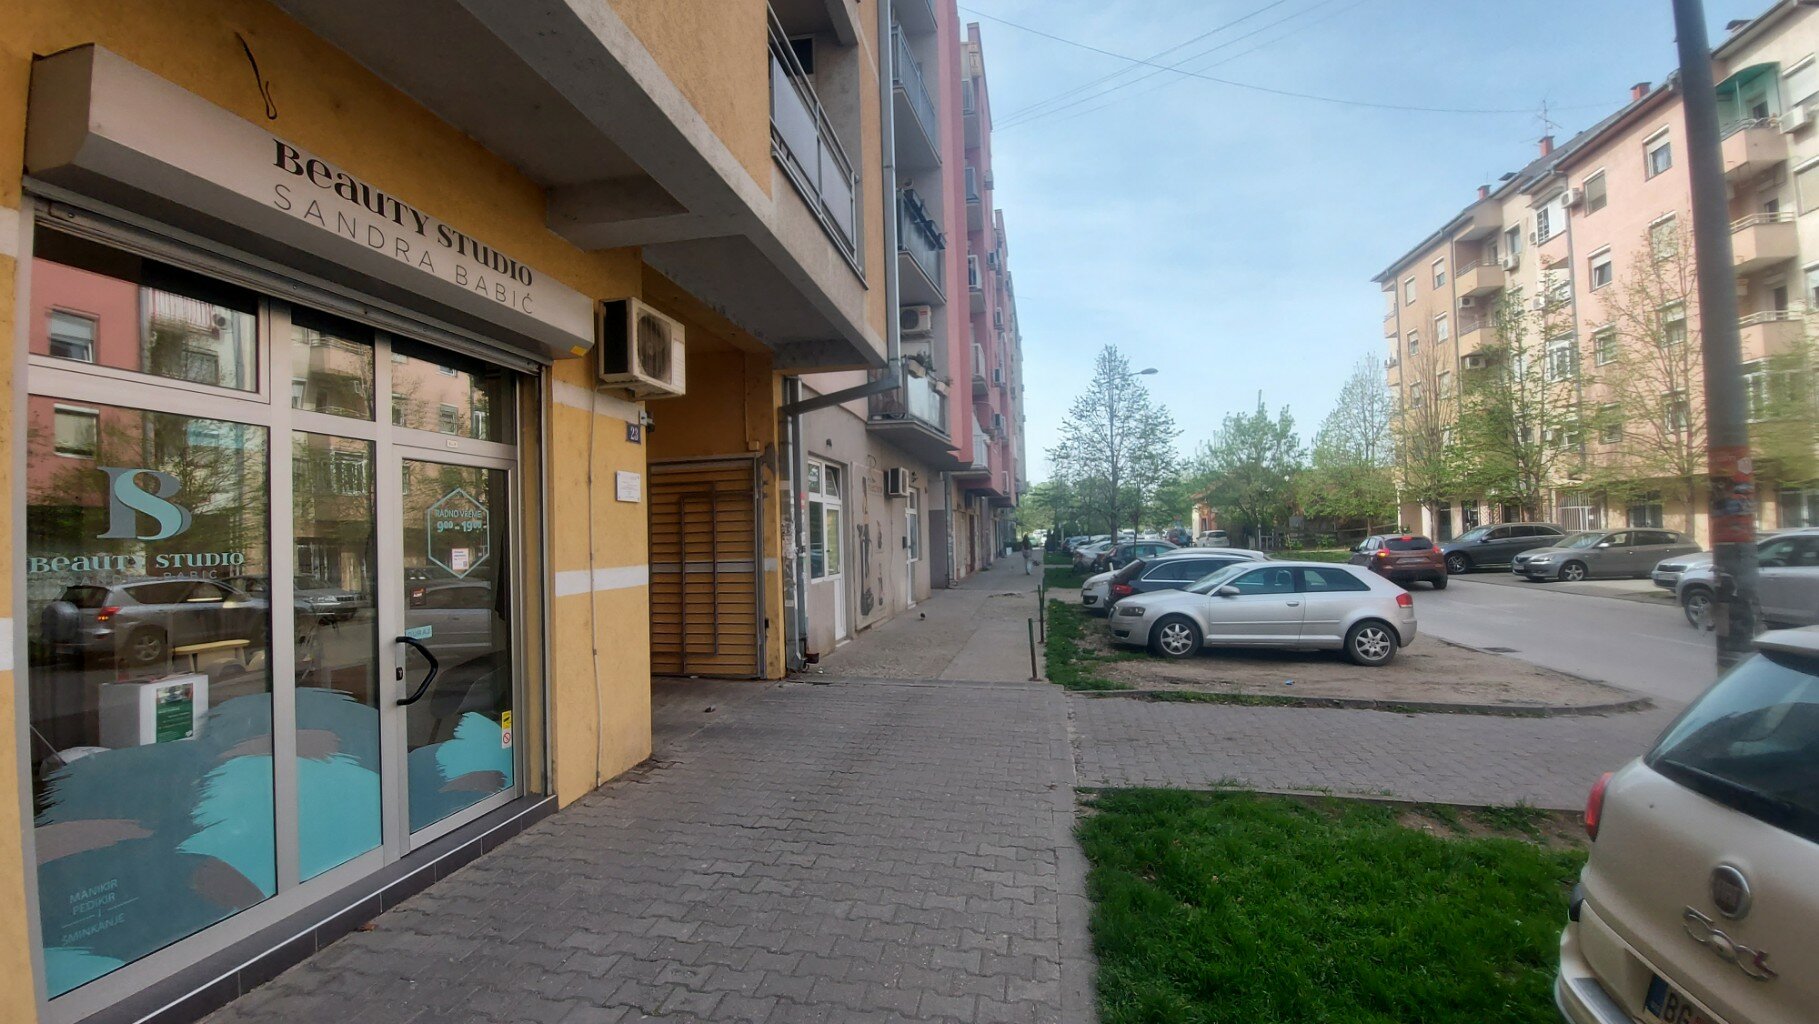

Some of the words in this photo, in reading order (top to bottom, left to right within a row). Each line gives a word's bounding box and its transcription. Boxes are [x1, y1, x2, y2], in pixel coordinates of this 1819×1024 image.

[273, 184, 435, 273] SANDRA
[455, 265, 533, 314] BABIĆ
[437, 223, 533, 287] STUDIO
[630, 426, 640, 440] 23
[435, 509, 459, 518] RADNO
[460, 510, 482, 518] VREME
[155, 552, 244, 569] STUDIO
[69, 879, 118, 903] MANIKIR
[72, 892, 116, 916] PEDIKIR
